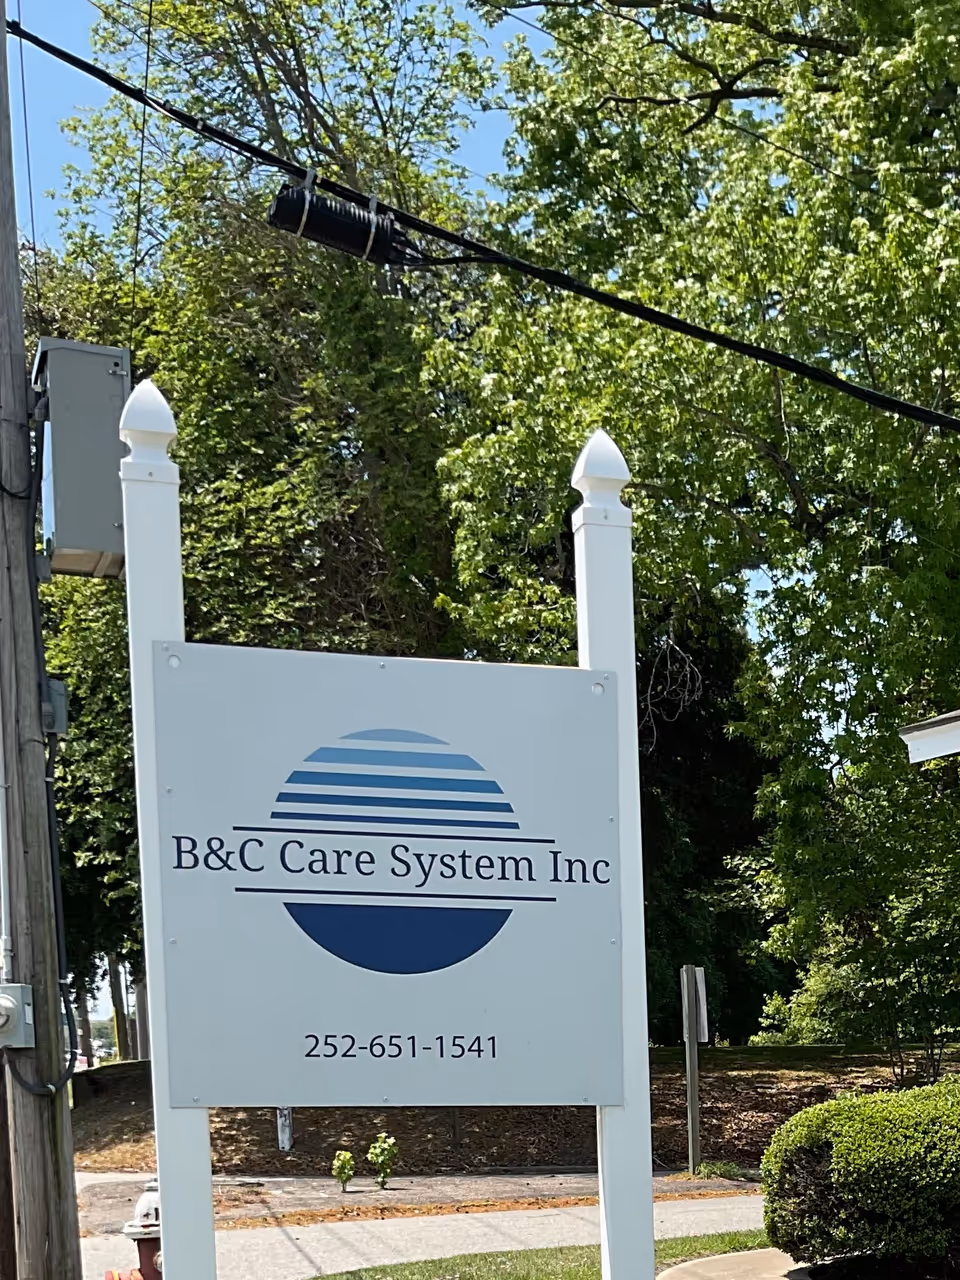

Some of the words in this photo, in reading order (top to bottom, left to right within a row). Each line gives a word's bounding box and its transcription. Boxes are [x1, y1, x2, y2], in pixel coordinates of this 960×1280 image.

[171, 834, 266, 873] B&C
[279, 839, 377, 877] Care
[389, 843, 538, 888] System
[548, 849, 612, 884] Inc
[303, 1034, 498, 1059] 252-651-1541
